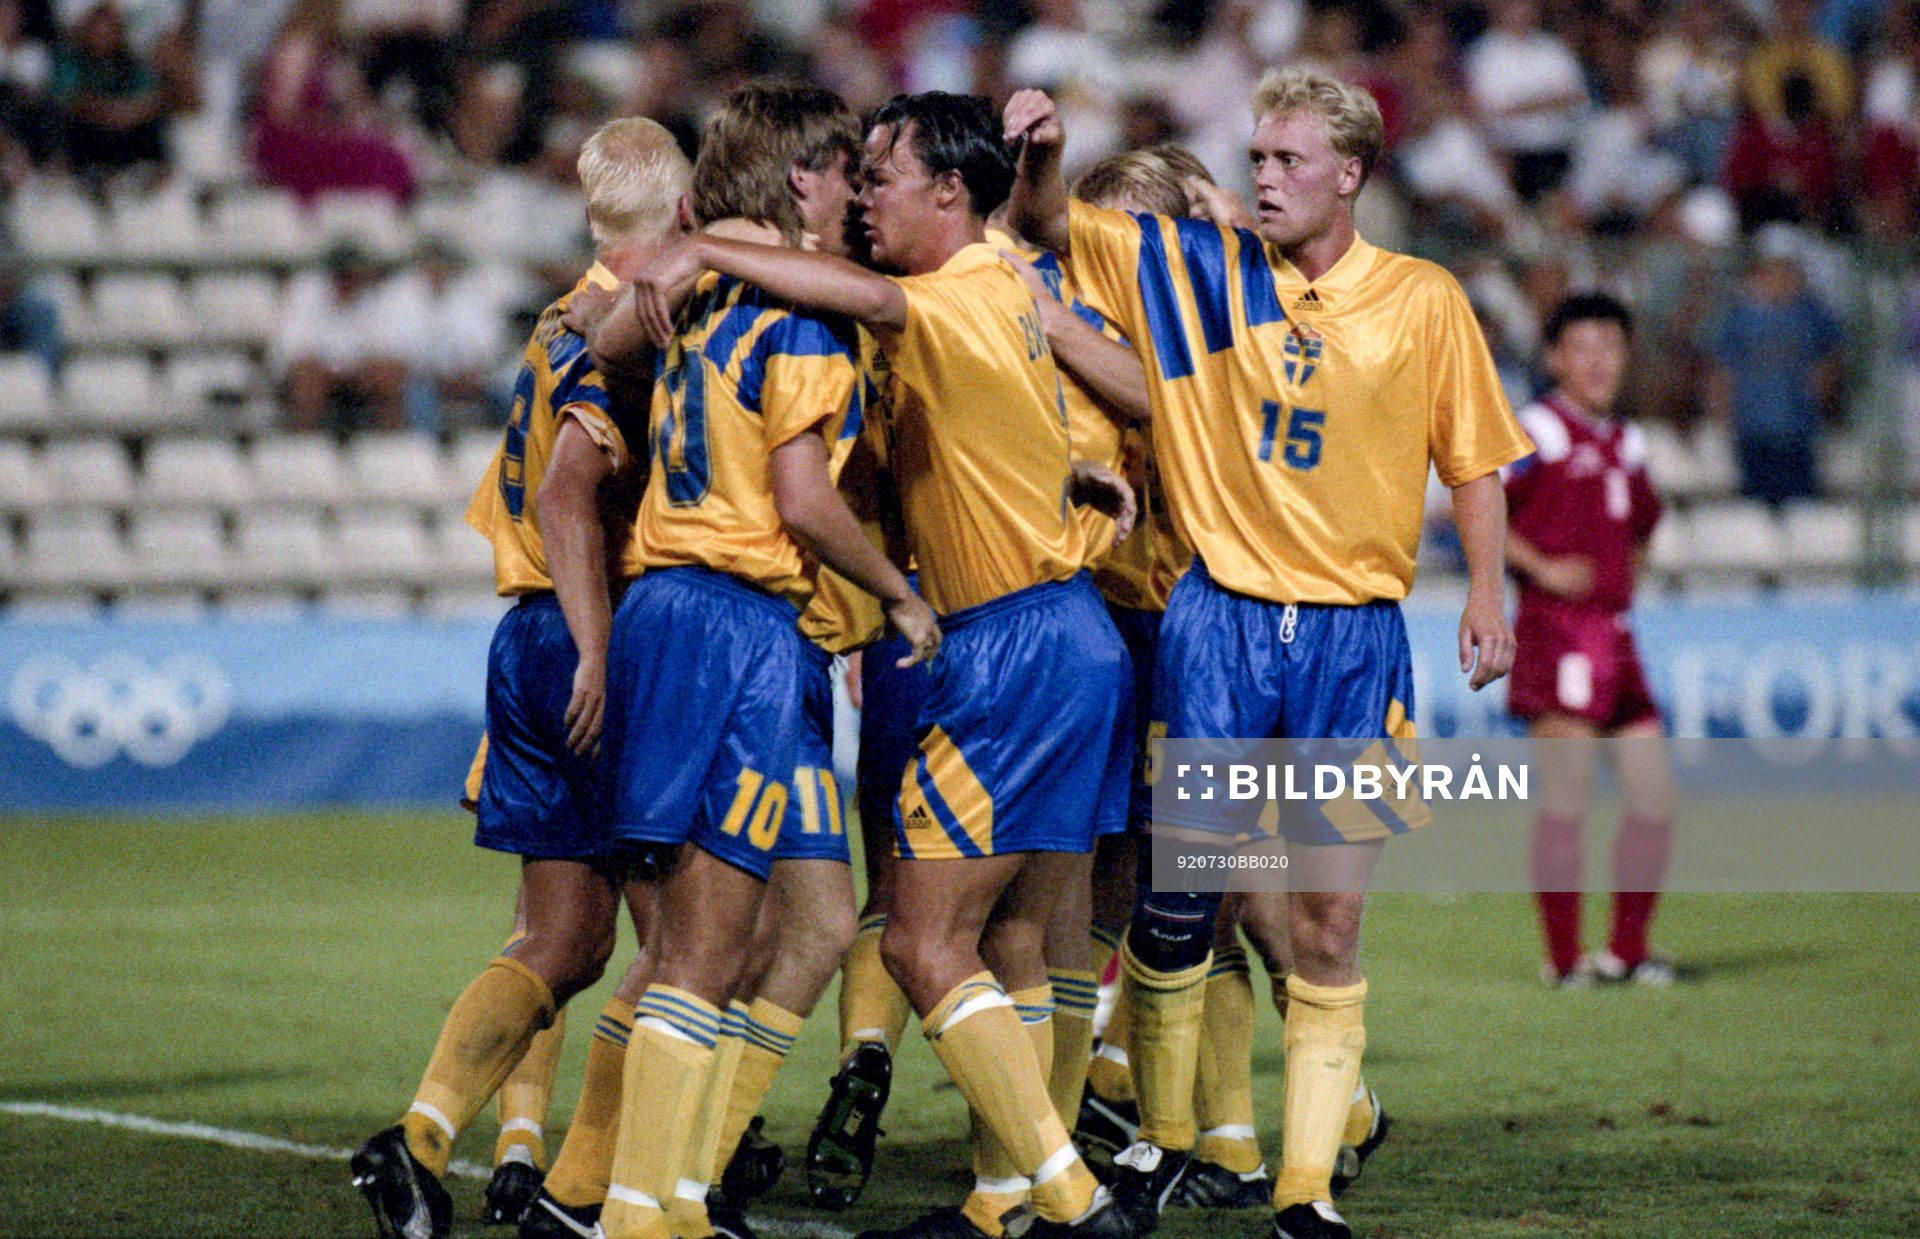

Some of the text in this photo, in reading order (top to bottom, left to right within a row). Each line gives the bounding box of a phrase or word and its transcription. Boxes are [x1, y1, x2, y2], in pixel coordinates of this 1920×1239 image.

[1257, 398, 1327, 473] 15
[719, 766, 787, 852] 10
[794, 766, 843, 835] 11
